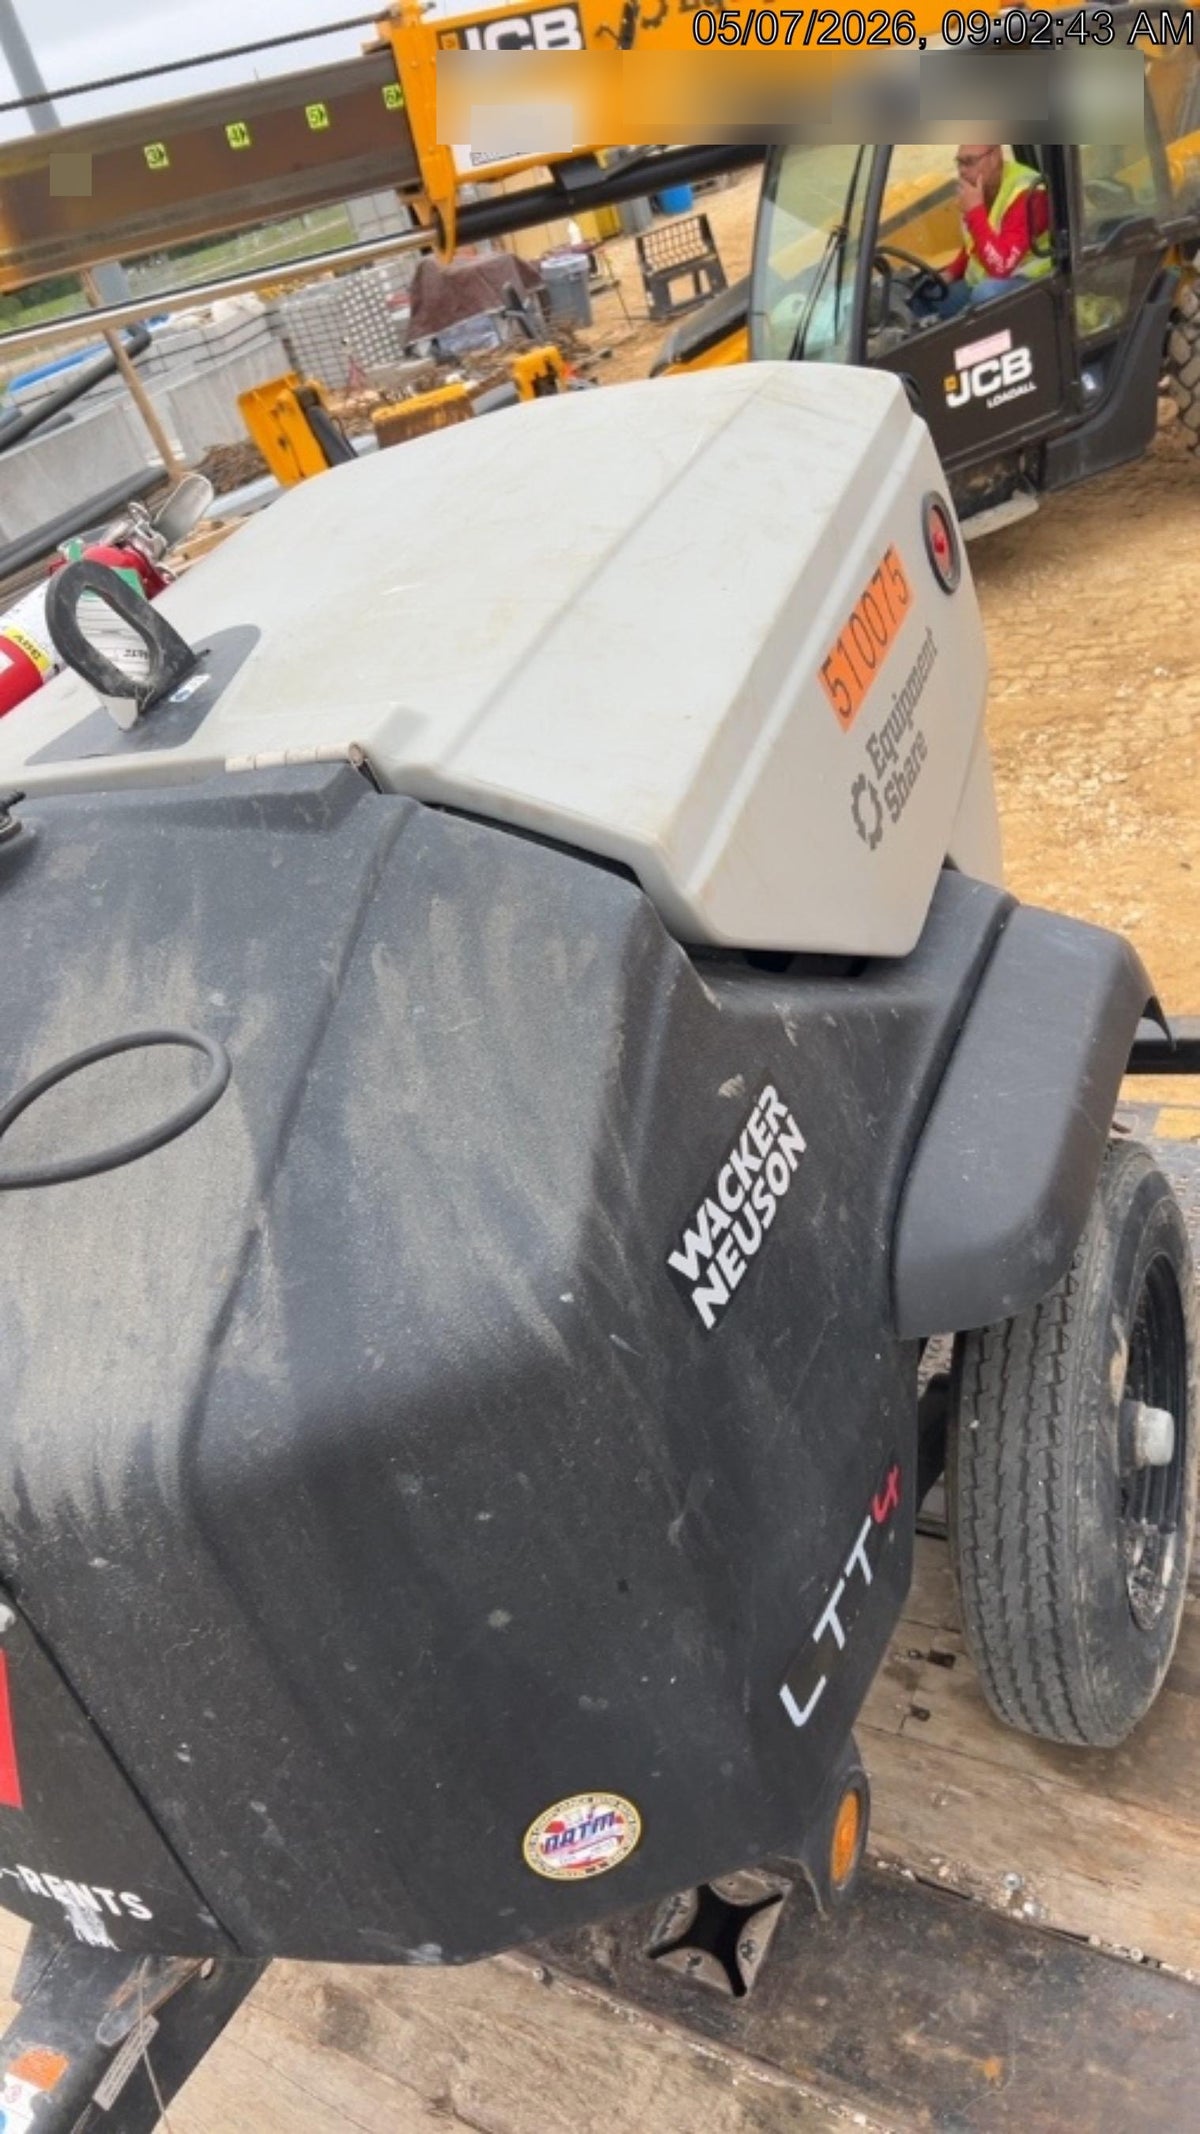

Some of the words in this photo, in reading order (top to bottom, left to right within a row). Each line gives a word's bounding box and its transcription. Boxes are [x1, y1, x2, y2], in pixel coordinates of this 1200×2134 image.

[946, 347, 1032, 408] JCB
[821, 547, 911, 718] 510075
[866, 627, 938, 780] Equipment
[884, 730, 928, 824] Share
[667, 1085, 788, 1281] WACKER
[691, 1114, 807, 1330] NEUSON
